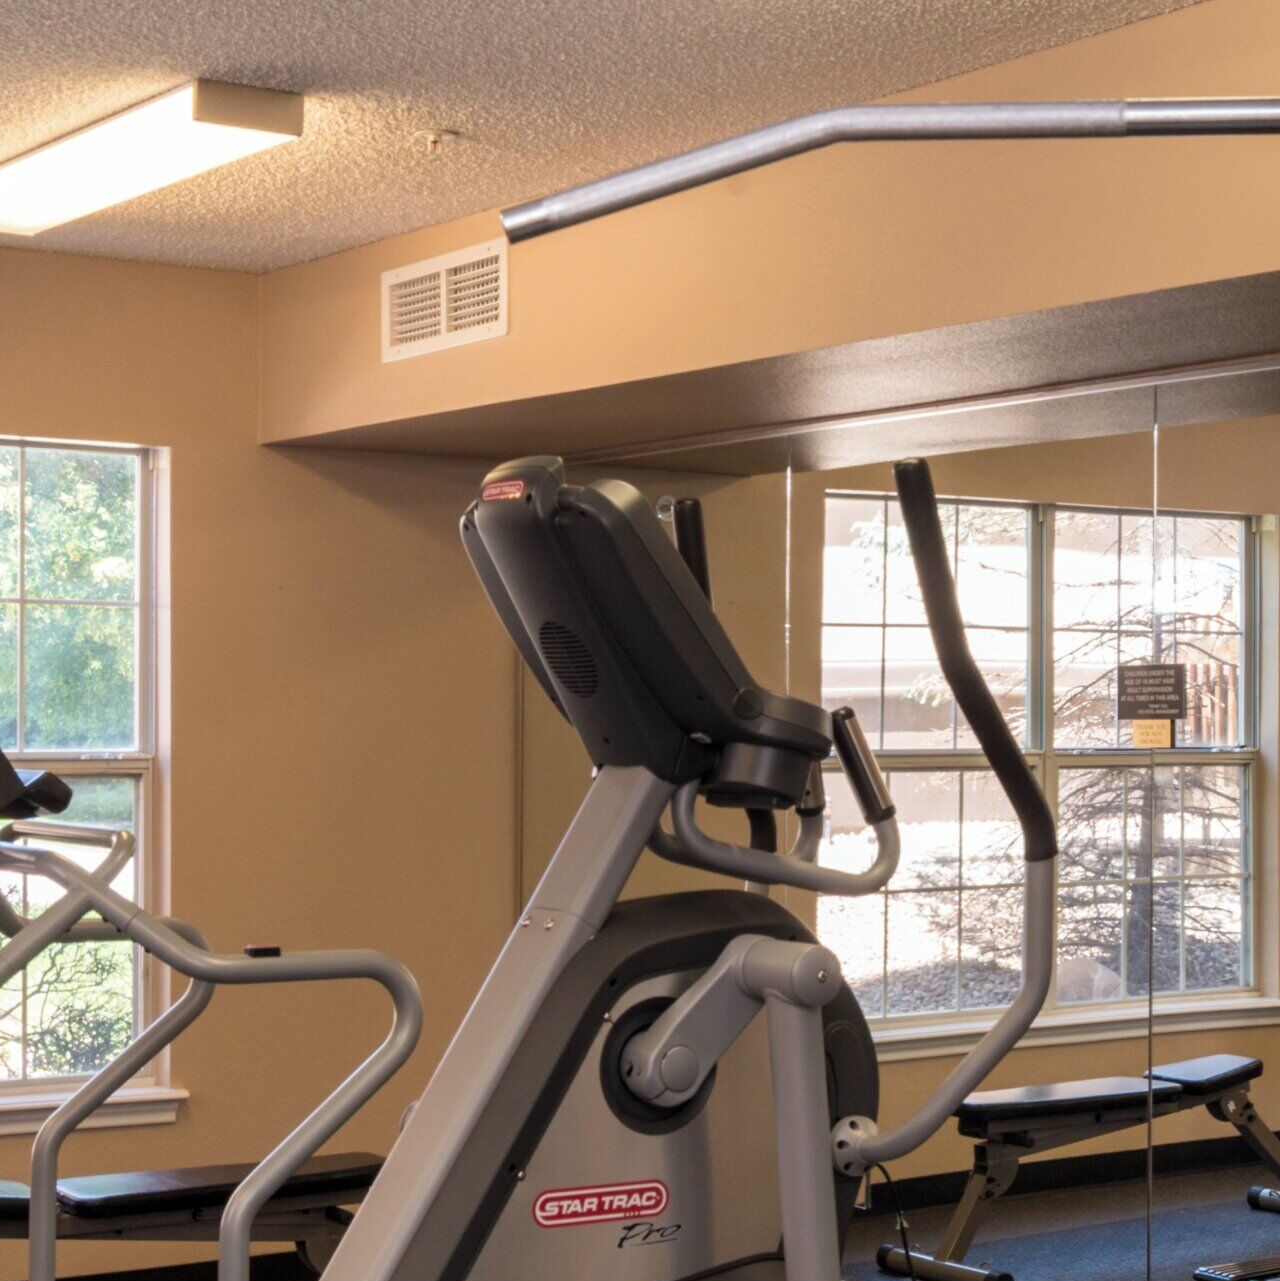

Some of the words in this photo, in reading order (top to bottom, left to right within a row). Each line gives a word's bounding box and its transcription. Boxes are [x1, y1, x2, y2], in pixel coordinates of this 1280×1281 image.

[544, 1199, 598, 1216] STAR
[600, 1191, 658, 1210] TRAC
[617, 1221, 682, 1249] Pro
